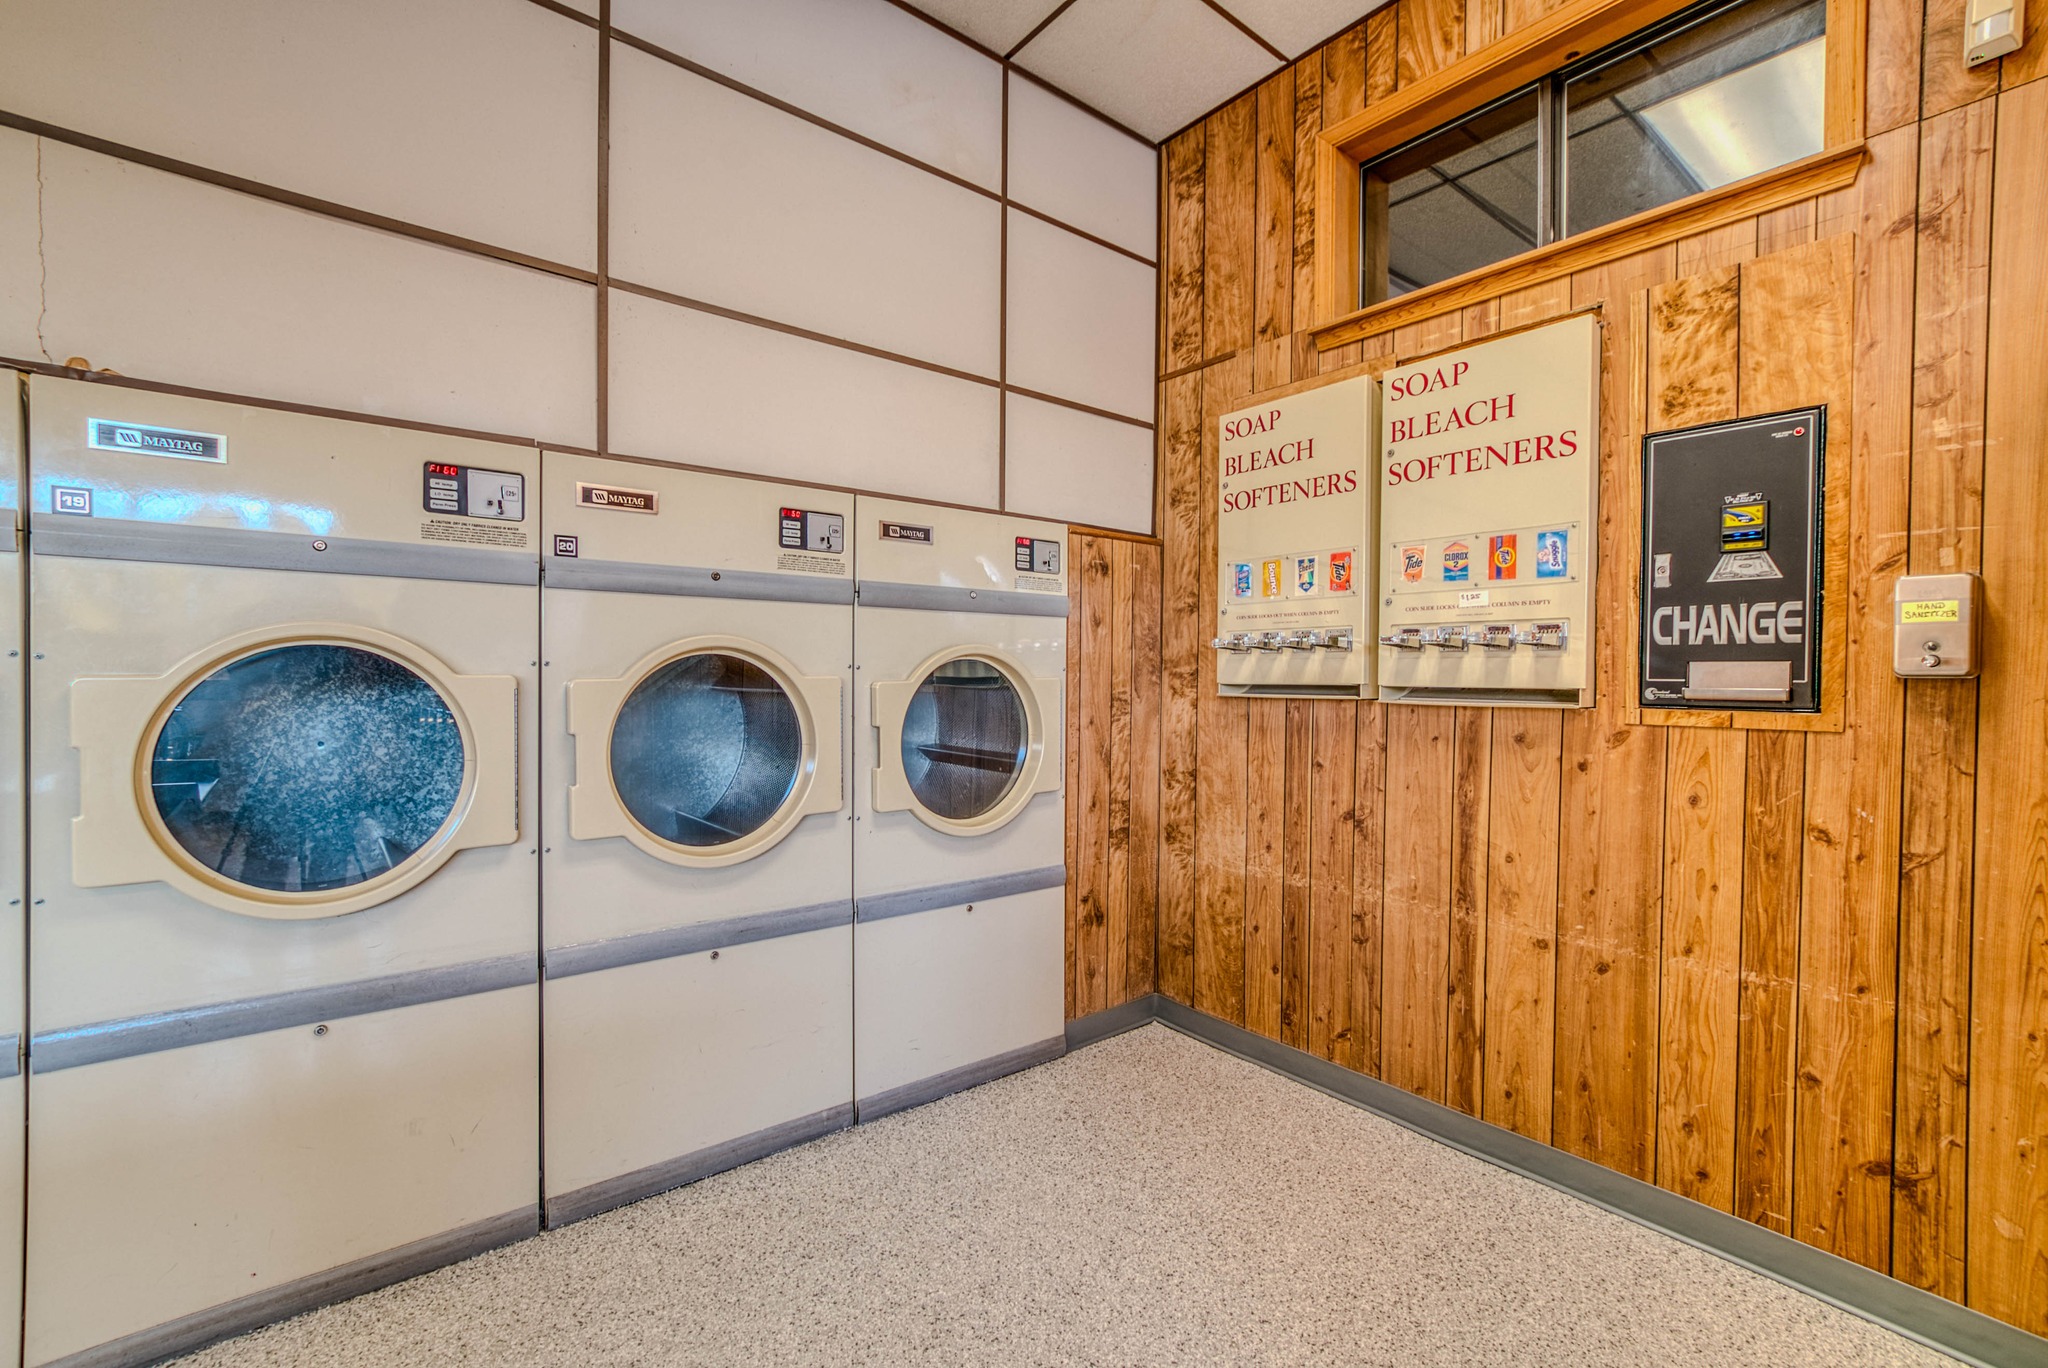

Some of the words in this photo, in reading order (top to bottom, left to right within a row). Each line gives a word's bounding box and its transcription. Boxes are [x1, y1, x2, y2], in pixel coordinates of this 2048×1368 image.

[1390, 361, 1469, 402] SOAP
[1224, 409, 1281, 442] SOAP
[1390, 393, 1517, 444] BLEACH
[143, 435, 203, 451] MAYTAG
[1224, 437, 1315, 477] BLEACH
[1388, 429, 1578, 486] SOFTENERS
[1223, 469, 1357, 513] SOFTENERS
[62, 495, 85, 508] 19
[608, 494, 645, 506] MAYTAG
[900, 529, 925, 538] MAYTAG
[559, 541, 574, 551] 20
[1404, 554, 1423, 573] Tide
[1444, 552, 1469, 562] CLOROX
[1453, 560, 1459, 568] 2
[1499, 549, 1510, 565] Tide
[1267, 563, 1278, 594] Bounce
[1332, 562, 1346, 581] Tide
[1492, 601, 1520, 609] COLUMN
[1916, 602, 1946, 610] HAND
[1652, 600, 1804, 646] CHANGE
